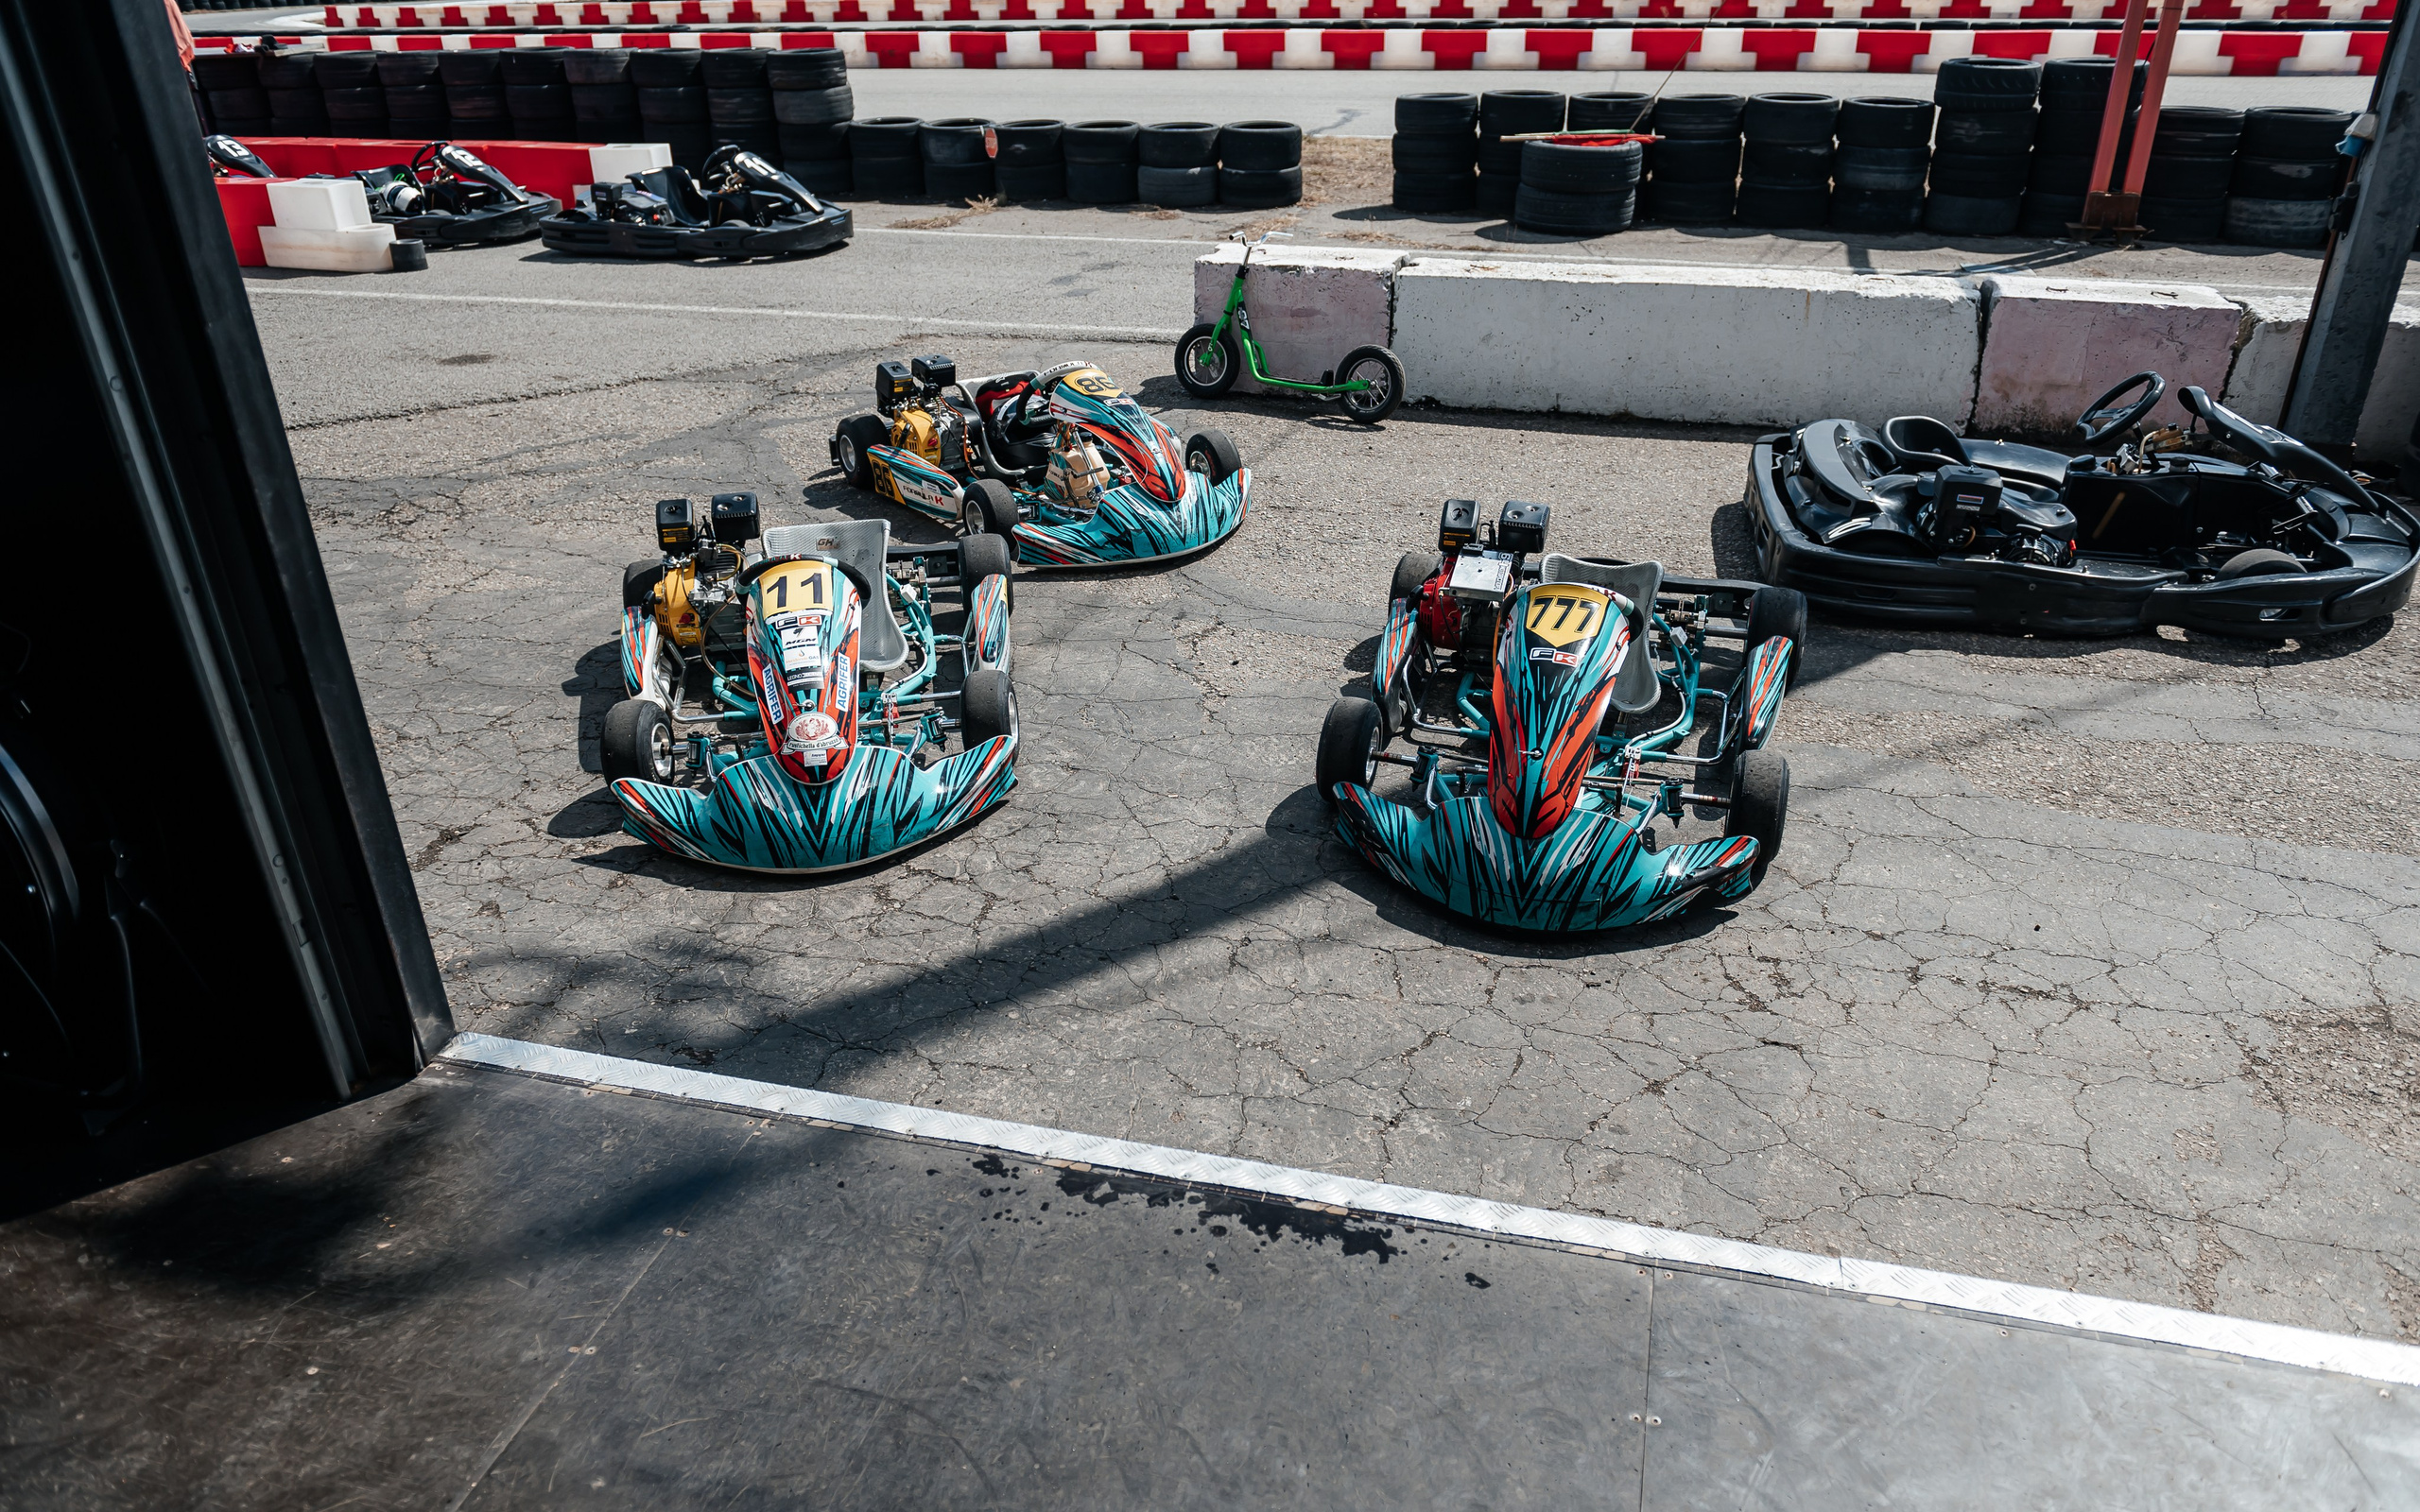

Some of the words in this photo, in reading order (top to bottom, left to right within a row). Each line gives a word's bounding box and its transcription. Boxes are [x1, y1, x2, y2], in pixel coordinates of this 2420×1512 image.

[216, 139, 250, 158] 13
[450, 149, 483, 167] 12
[743, 157, 776, 176] 11
[1076, 377, 1119, 393] 86
[872, 460, 895, 498] 86
[934, 495, 944, 506] K
[766, 572, 823, 609] 11
[1530, 595, 1601, 633] 777
[764, 668, 782, 721] AGRIFER
[838, 656, 848, 709] AGRIFER
